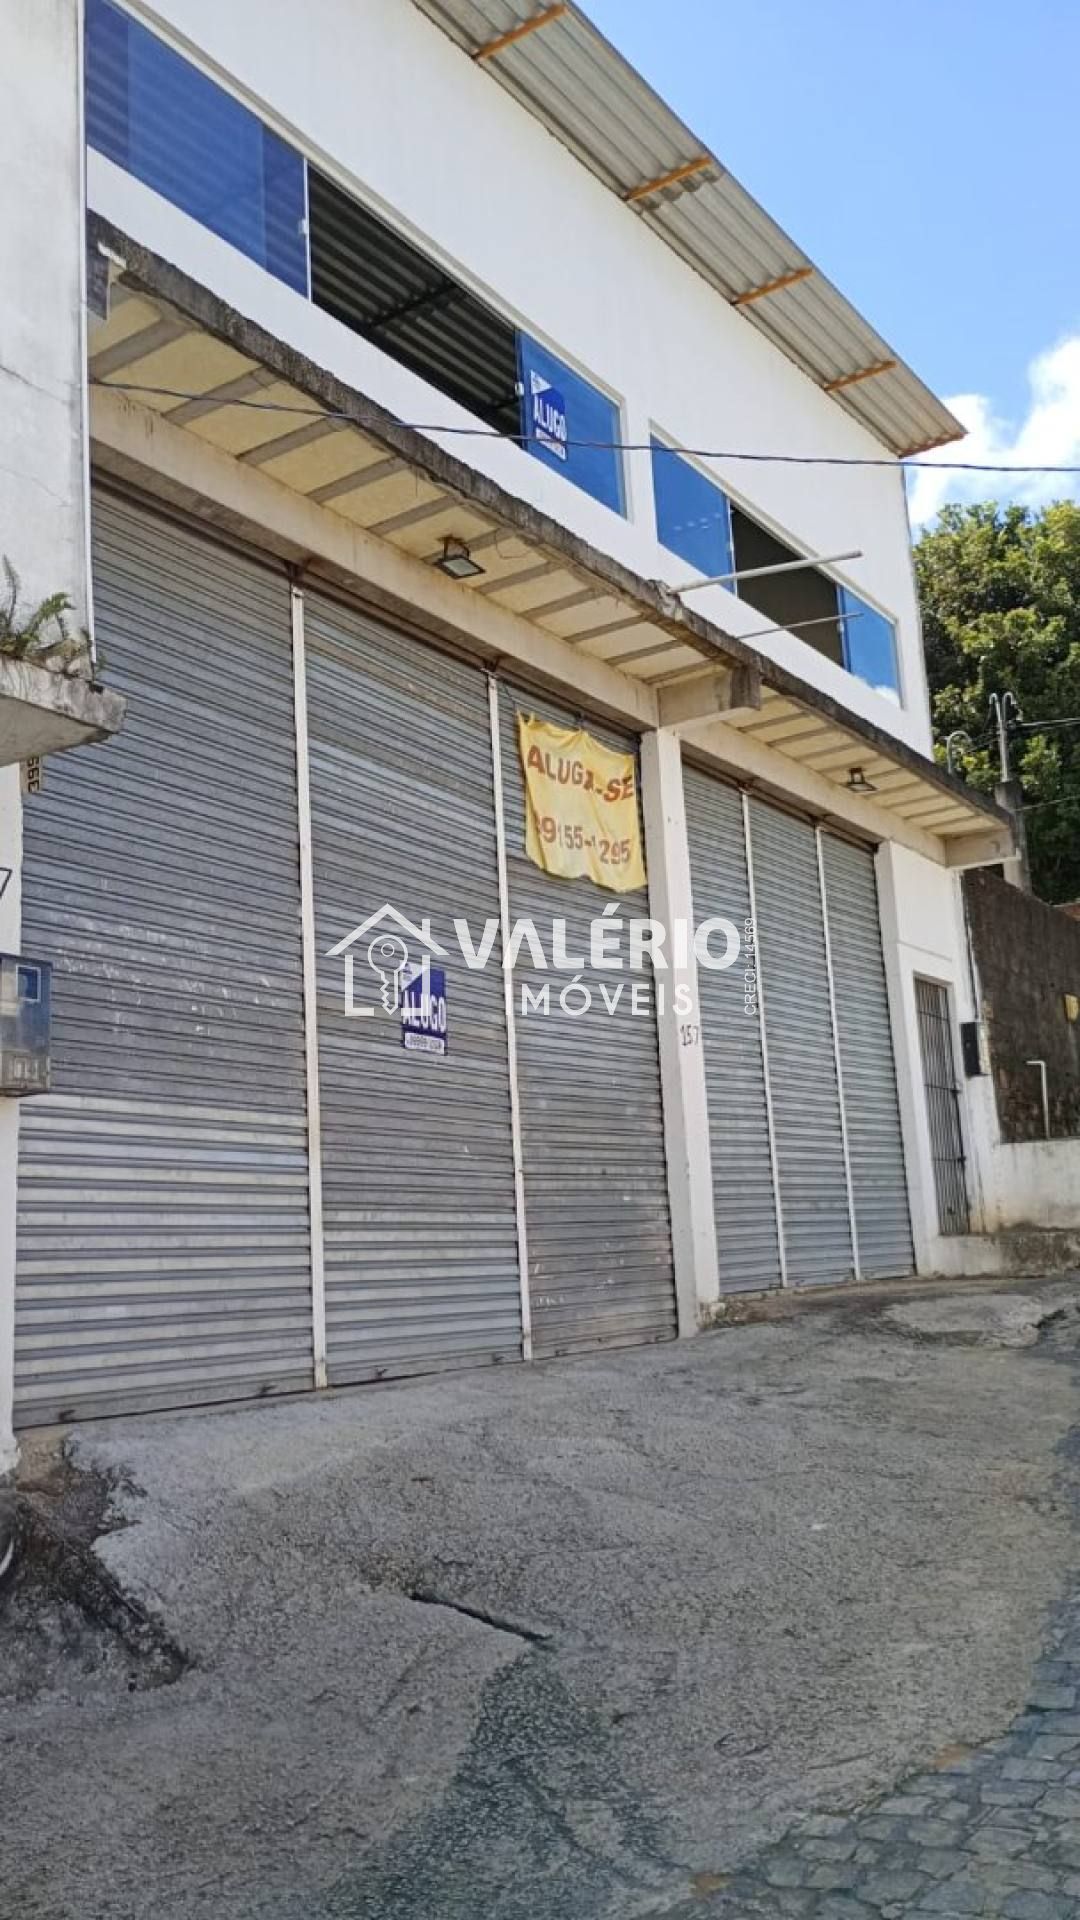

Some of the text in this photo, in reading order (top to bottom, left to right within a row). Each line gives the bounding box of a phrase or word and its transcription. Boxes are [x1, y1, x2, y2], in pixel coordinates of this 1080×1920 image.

[534, 393, 566, 441] ALUGO
[527, 745, 634, 802] ALUGA-SE
[402, 989, 447, 1033] ALUGO
